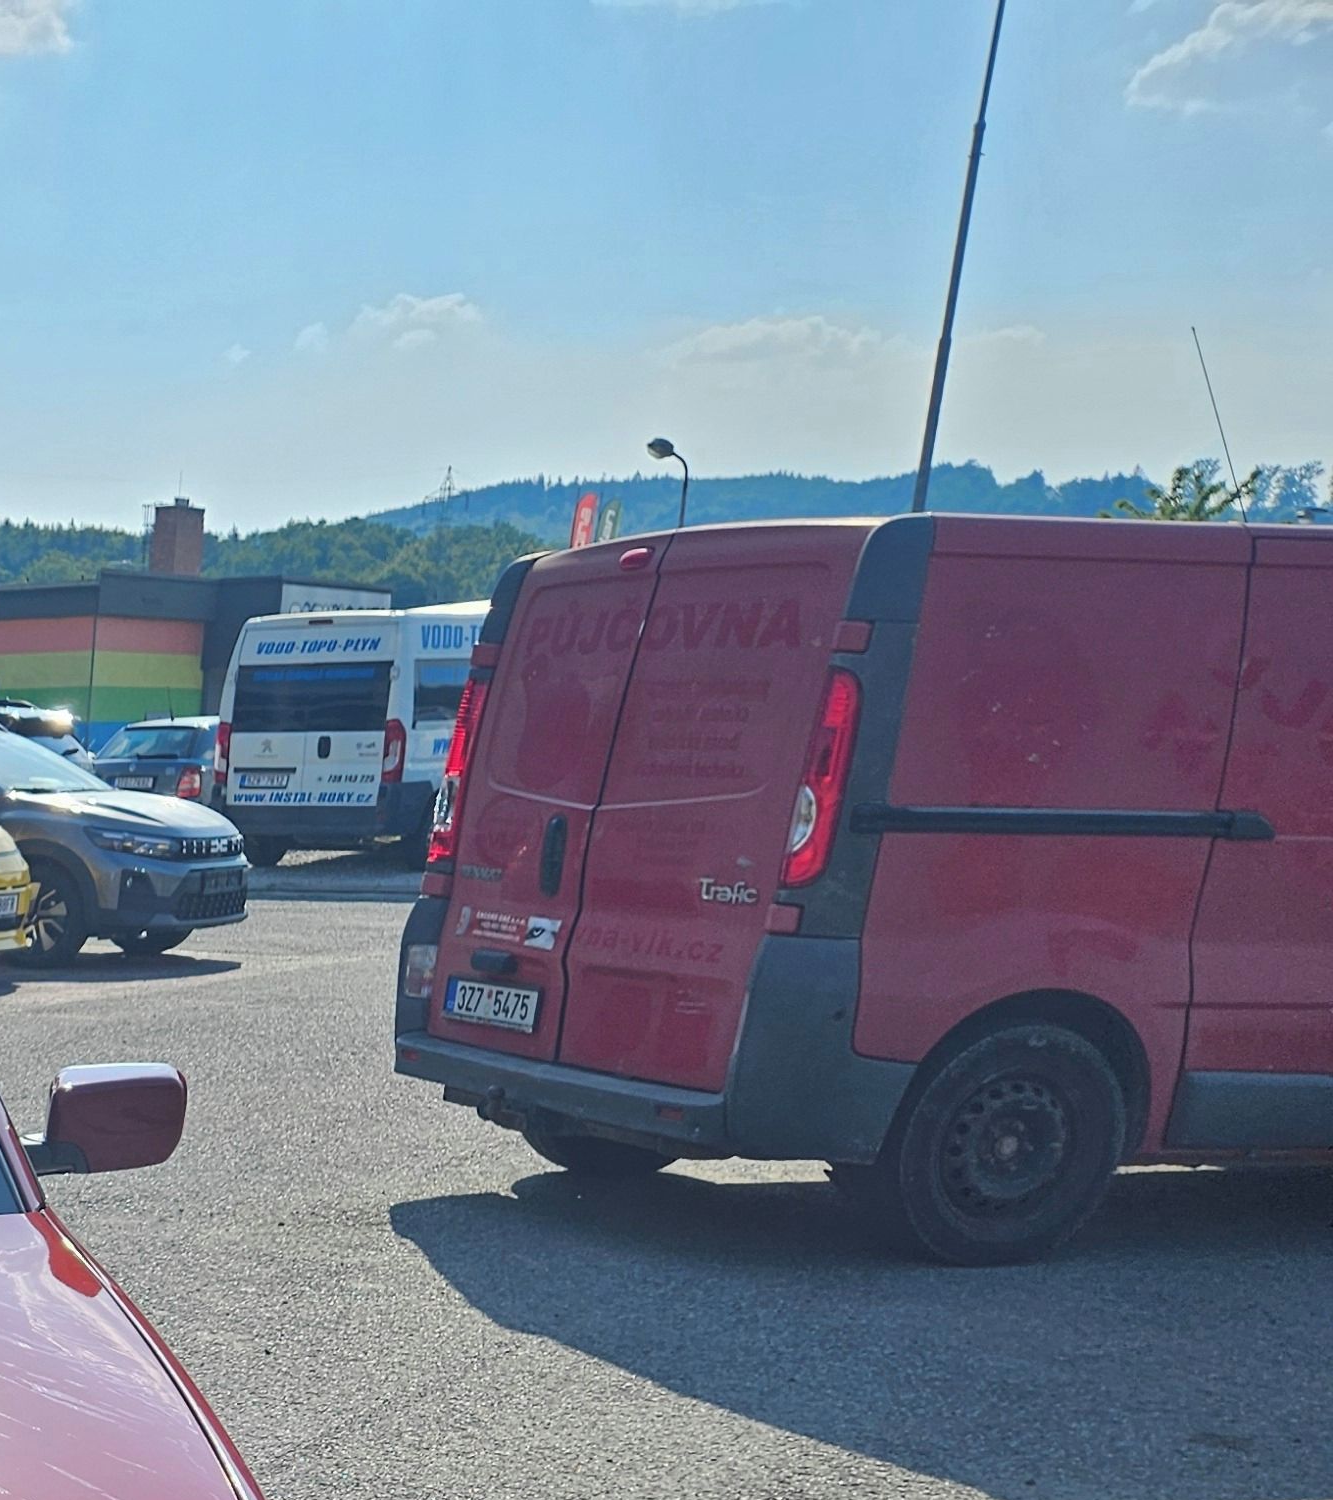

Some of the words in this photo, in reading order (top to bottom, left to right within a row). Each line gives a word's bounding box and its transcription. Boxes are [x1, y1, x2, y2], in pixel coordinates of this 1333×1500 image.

[698, 877, 759, 904] Trafic
[457, 986, 484, 1013] 3Z7
[493, 990, 530, 1021] 5475
